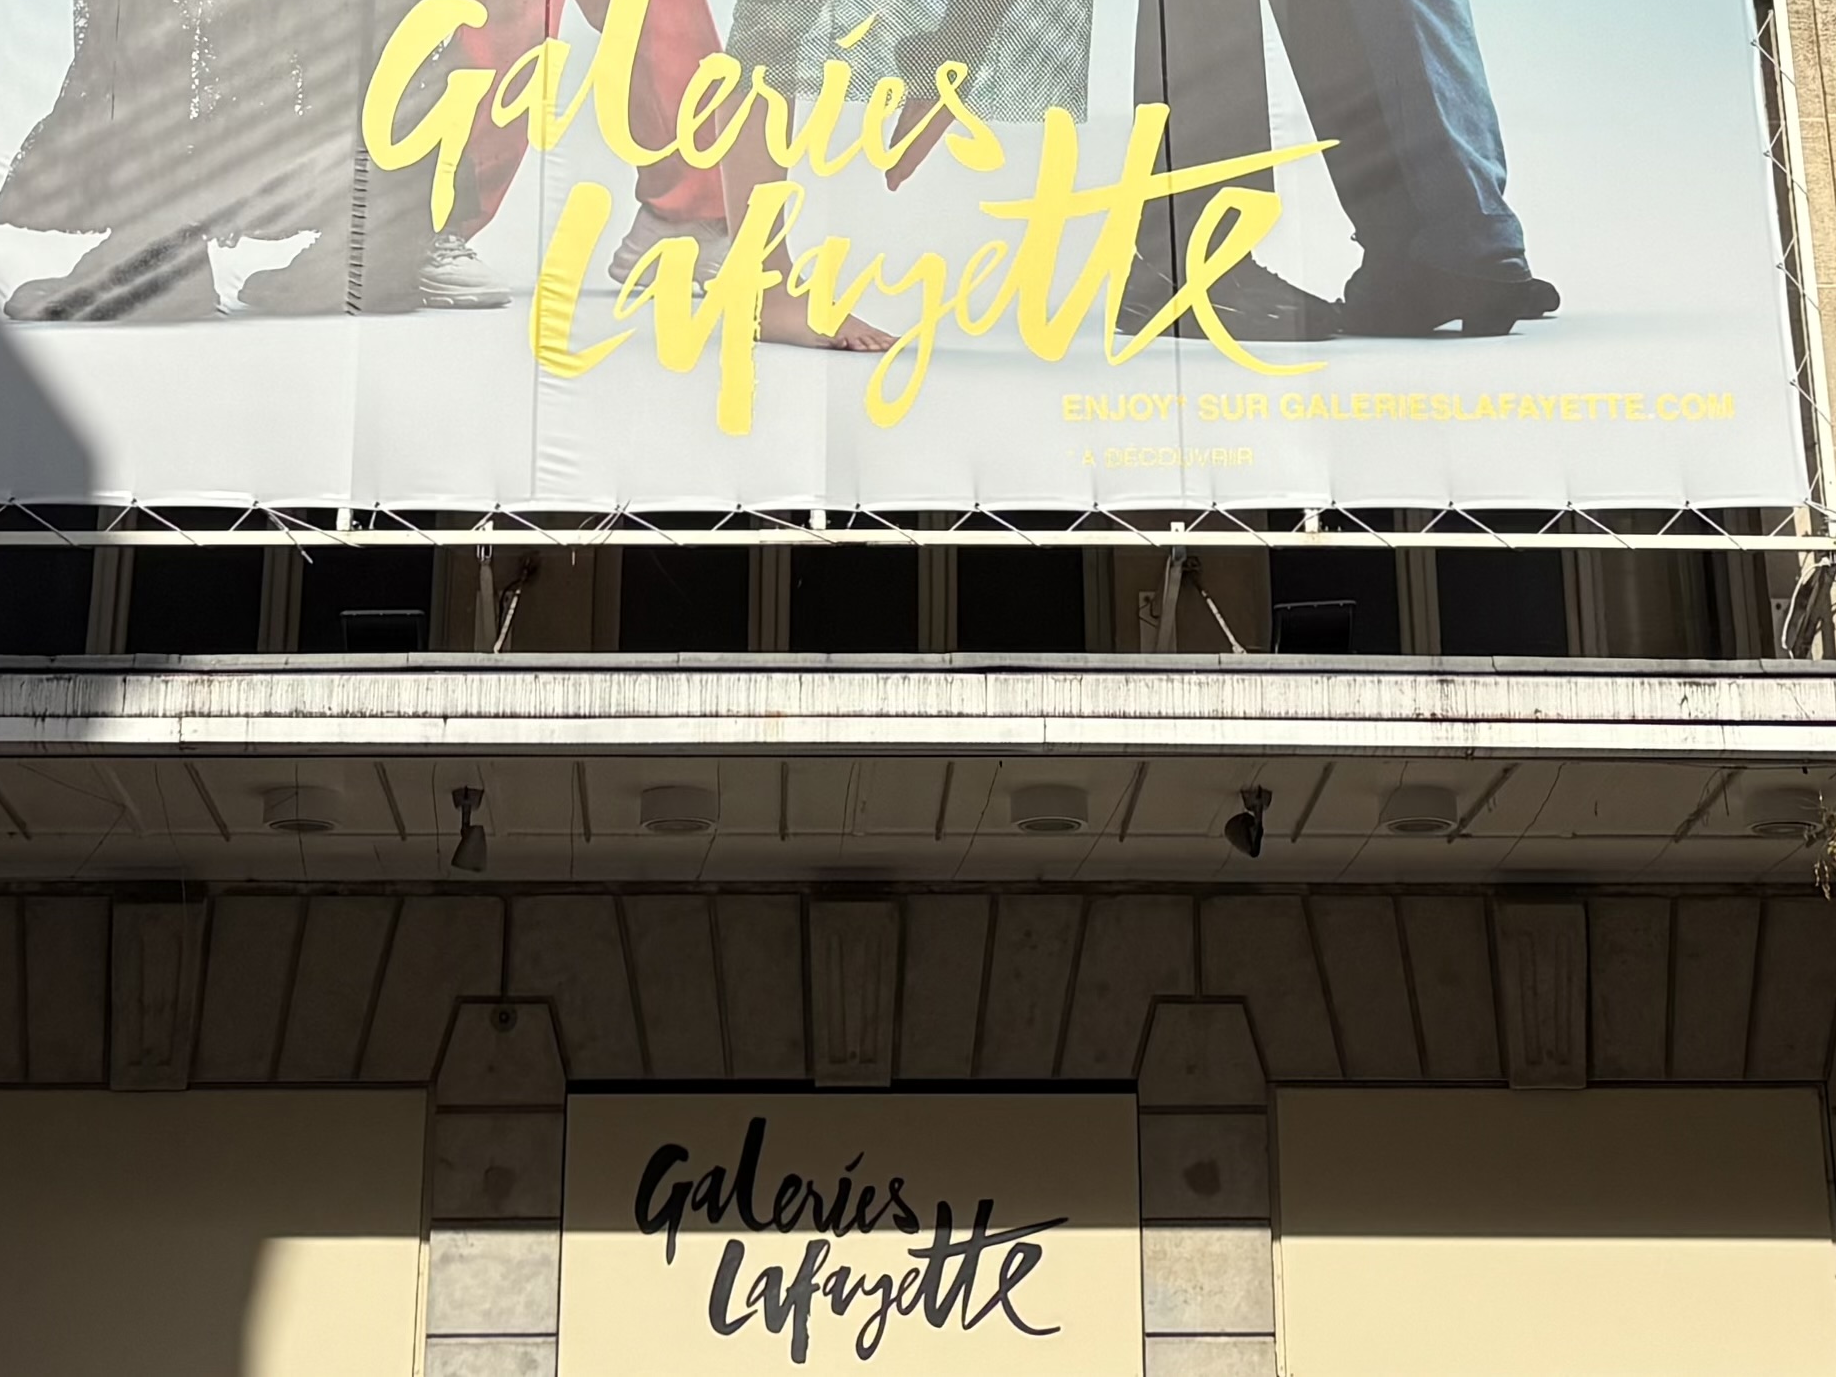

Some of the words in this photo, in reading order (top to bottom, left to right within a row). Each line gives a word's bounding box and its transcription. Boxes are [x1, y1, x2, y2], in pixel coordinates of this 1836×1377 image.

[528, 102, 1342, 435] Lafayette
[1197, 392, 1271, 423] SUR
[1278, 391, 1738, 423] GALERIESLAFAYETTE.COM
[634, 1116, 920, 1266] Galeries
[708, 1198, 1069, 1365] Lafayette
